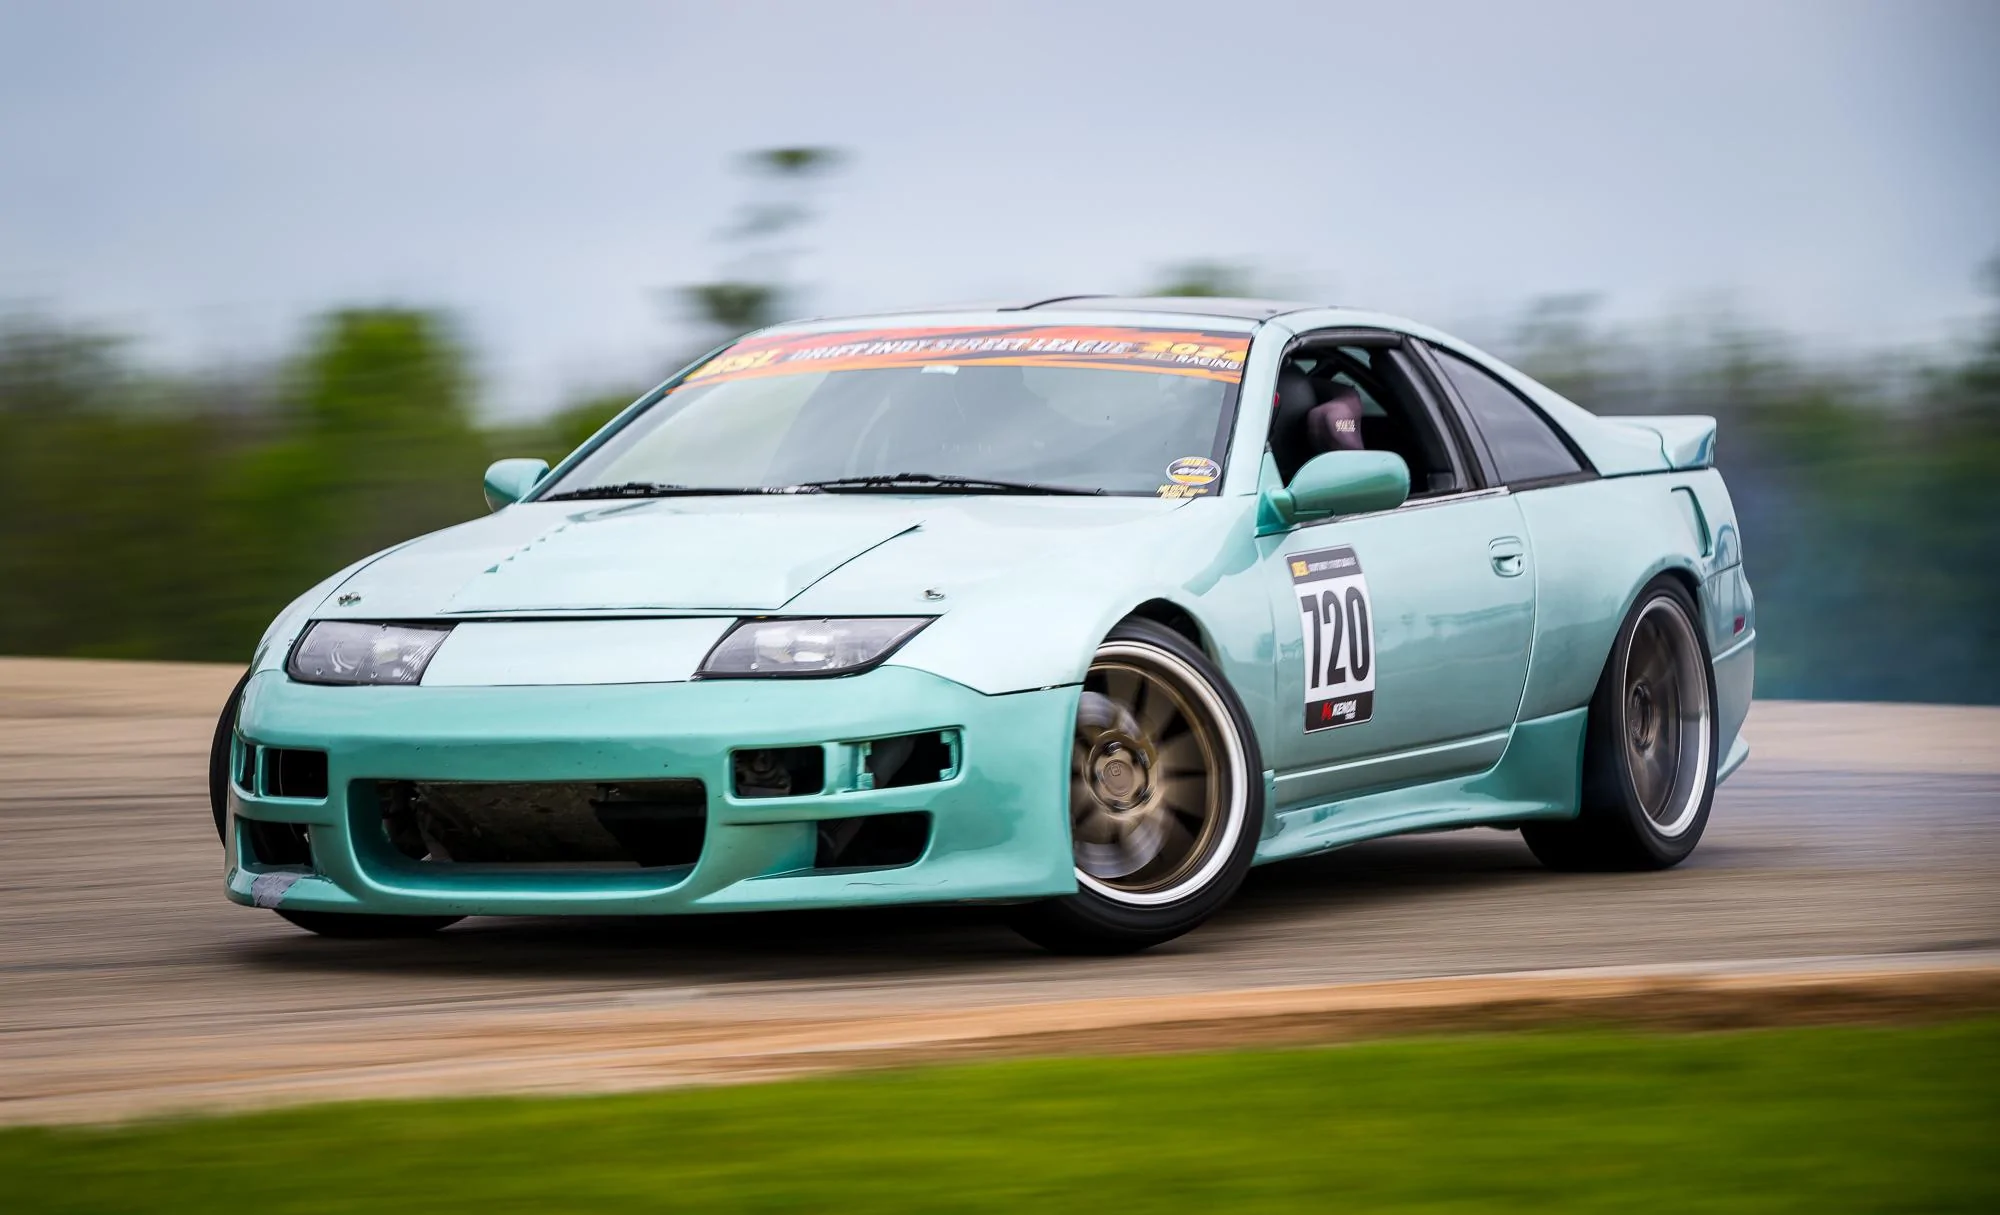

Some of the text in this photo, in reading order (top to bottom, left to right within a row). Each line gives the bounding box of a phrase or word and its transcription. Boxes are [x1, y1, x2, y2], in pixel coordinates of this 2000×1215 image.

[789, 338, 1135, 360] DRIFT INDY STREET LEAGUE
[1300, 586, 1370, 689] 720
